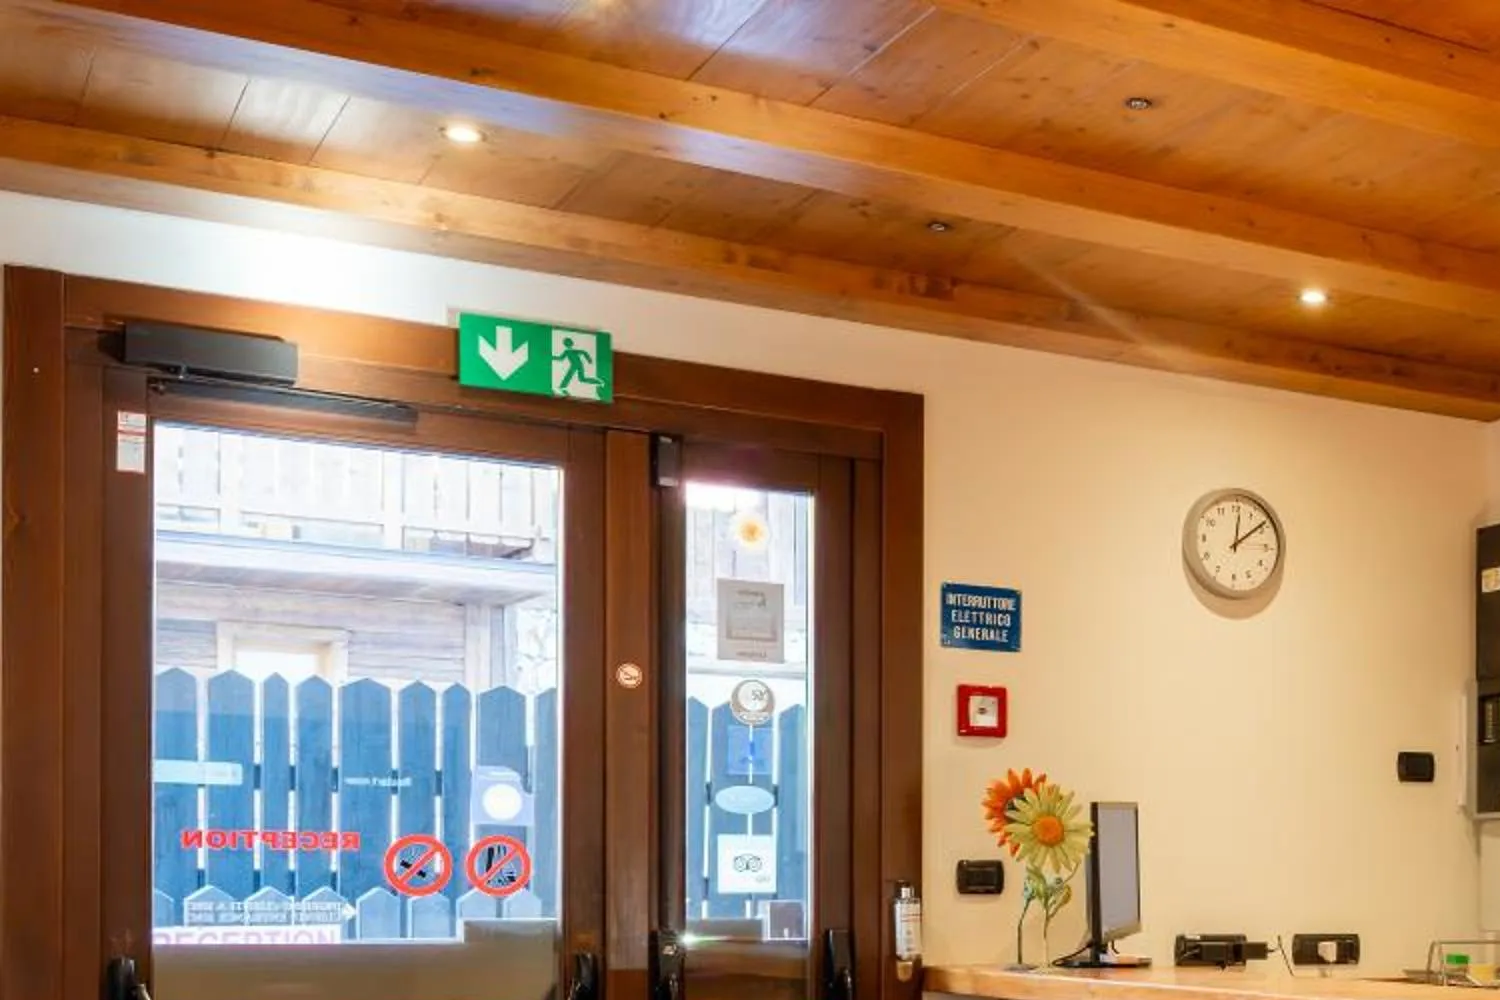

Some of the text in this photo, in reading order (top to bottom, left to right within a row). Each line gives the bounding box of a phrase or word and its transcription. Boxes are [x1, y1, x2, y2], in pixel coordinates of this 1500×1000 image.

[945, 592, 1016, 611] INTERRUTTORE
[951, 609, 1011, 626] ELETTRICO
[953, 625, 1009, 643] GENERALE
